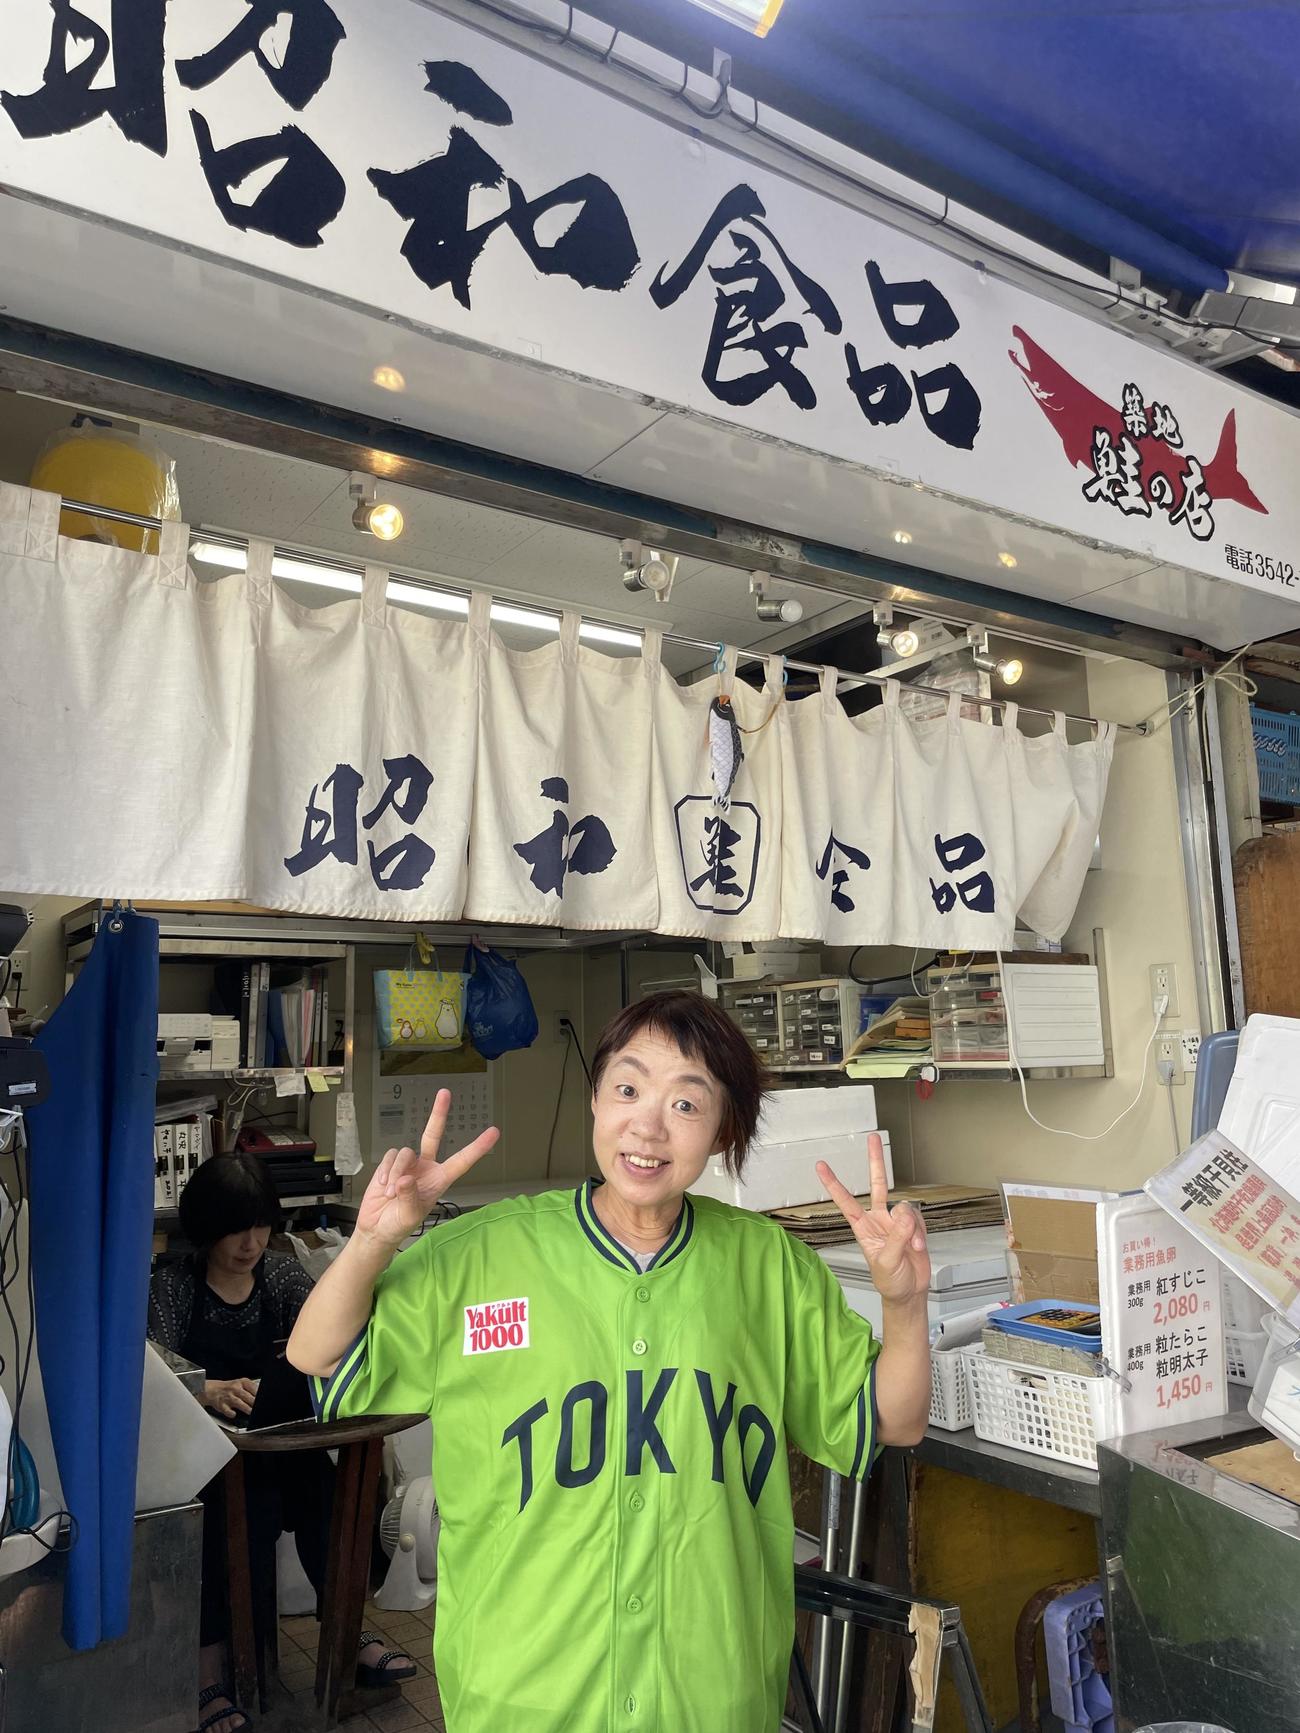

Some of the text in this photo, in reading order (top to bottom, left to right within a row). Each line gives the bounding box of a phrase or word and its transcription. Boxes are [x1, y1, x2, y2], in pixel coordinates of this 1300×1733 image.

[1, 0, 981, 450] 昭和食品
[1122, 383, 1184, 449] 築地
[1082, 425, 1215, 542] 鮭の店
[392, 1083, 402, 1100] 9
[1123, 1246, 1177, 1274] 業務用魚卵
[1127, 1269, 1206, 1297] 業務用 紅すじこ
[466, 1301, 527, 1329] Yakult
[1127, 1297, 1144, 1309] 300g
[1153, 1293, 1198, 1326] 2,080
[469, 1323, 524, 1352] 1000
[1127, 1326, 1207, 1360] 業務用 粒たらこ
[1127, 1360, 1144, 1372] 400g
[1156, 1348, 1208, 1379] 粒明太子
[1156, 1374, 1201, 1409] 1,450
[501, 1367, 777, 1514] TOKYO
